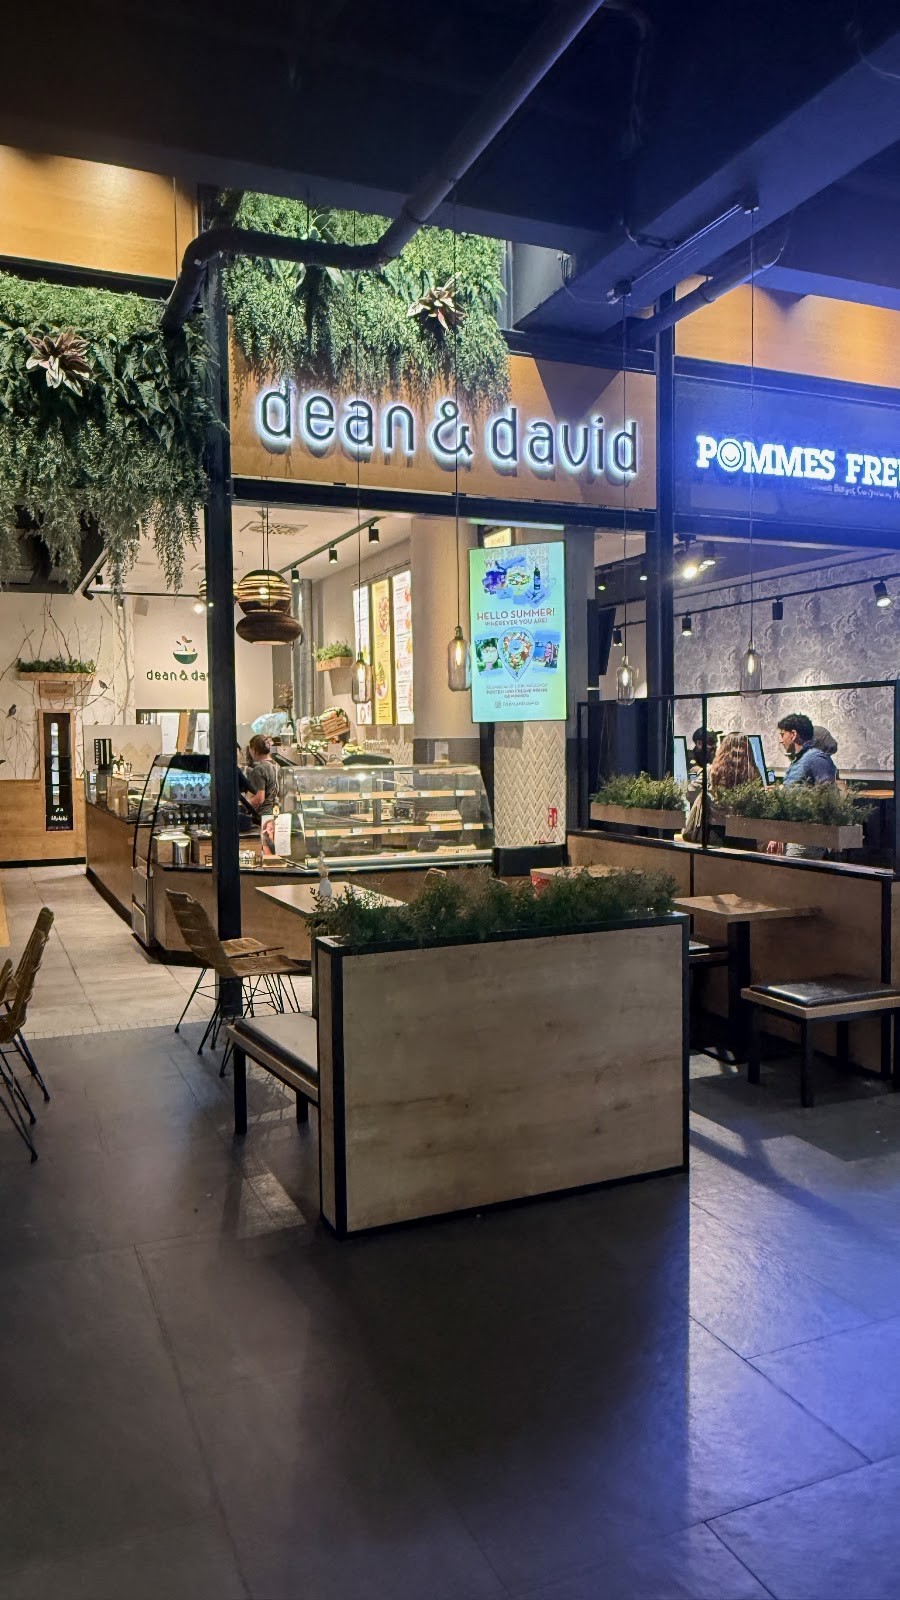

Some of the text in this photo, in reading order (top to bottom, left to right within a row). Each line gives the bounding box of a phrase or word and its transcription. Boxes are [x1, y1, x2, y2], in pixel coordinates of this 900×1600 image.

[259, 382, 638, 474] dean & david
[695, 435, 900, 488] POMMES FRE
[476, 608, 555, 620] HELLO SUMMER!
[146, 669, 177, 681] dean
[179, 669, 189, 681] &
